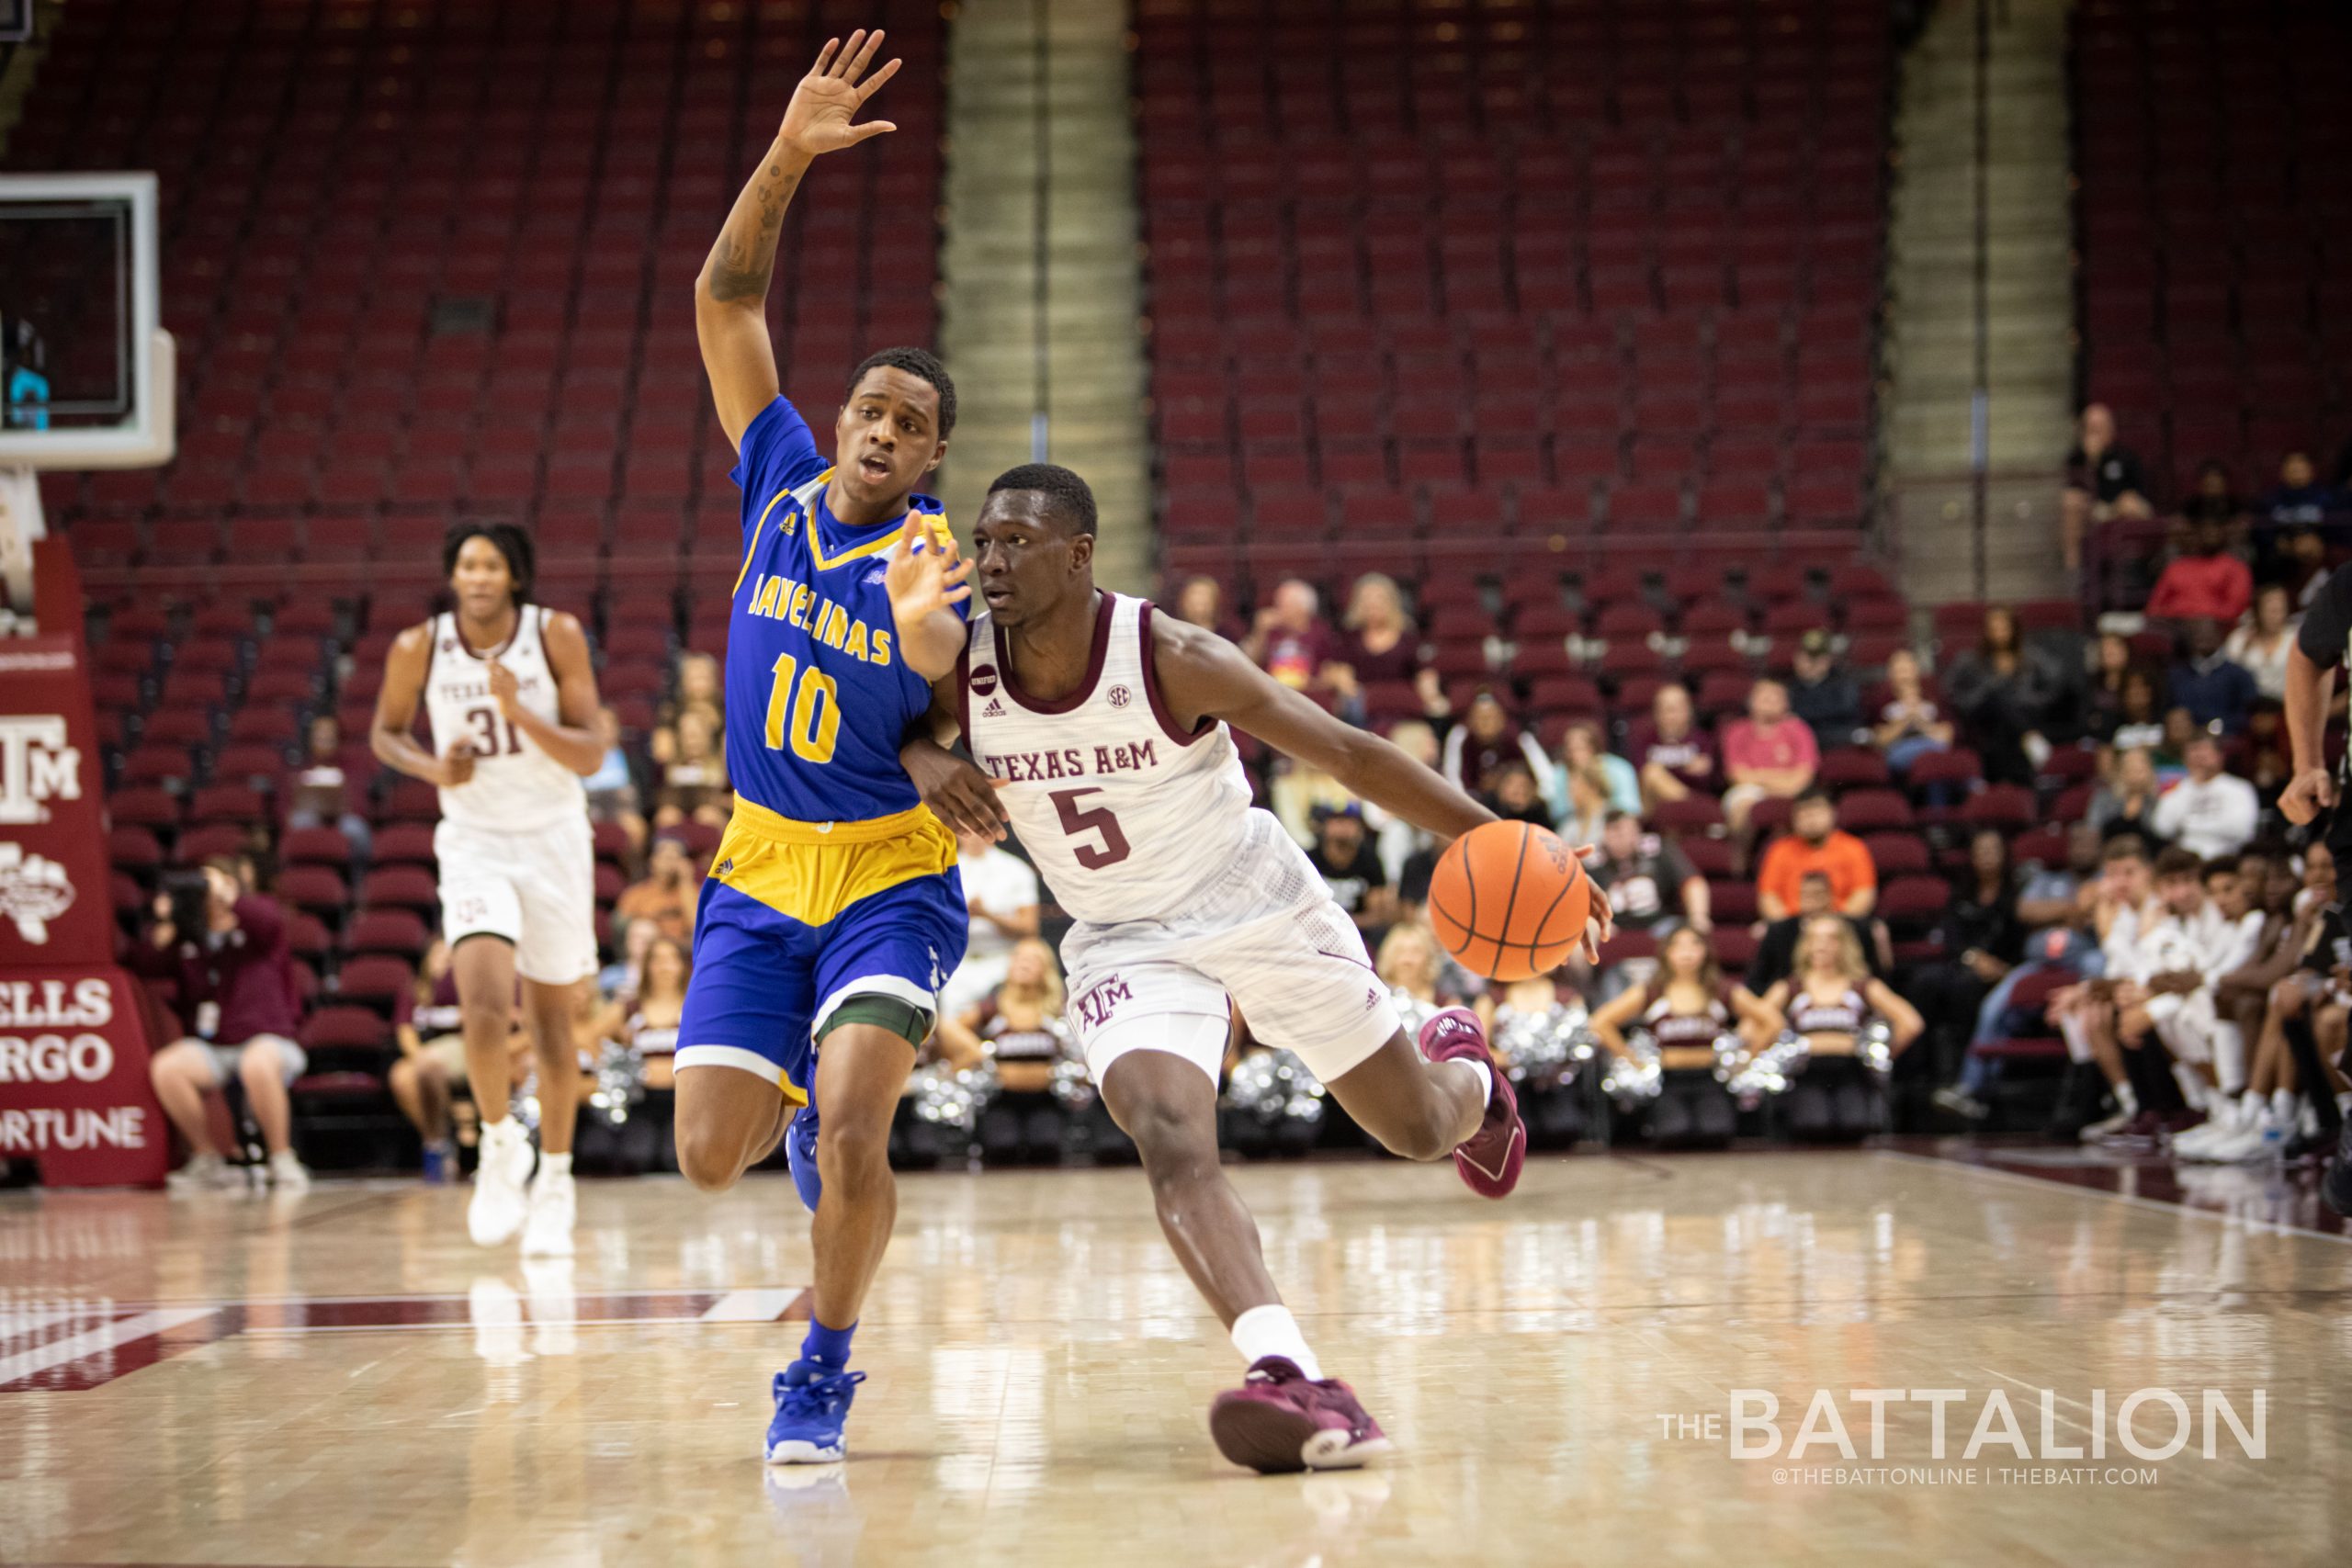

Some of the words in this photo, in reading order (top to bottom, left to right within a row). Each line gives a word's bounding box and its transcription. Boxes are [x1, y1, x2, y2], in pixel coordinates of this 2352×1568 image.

[748, 573, 892, 667] JAVELINAS
[765, 652, 842, 764] 10
[1110, 687, 1129, 706] SEC
[467, 708, 522, 758] 31
[985, 749, 1085, 782] TEXAS
[1094, 739, 1159, 774] A&M
[1048, 786, 1131, 871] 5
[0, 1106, 145, 1150] RTUNE
